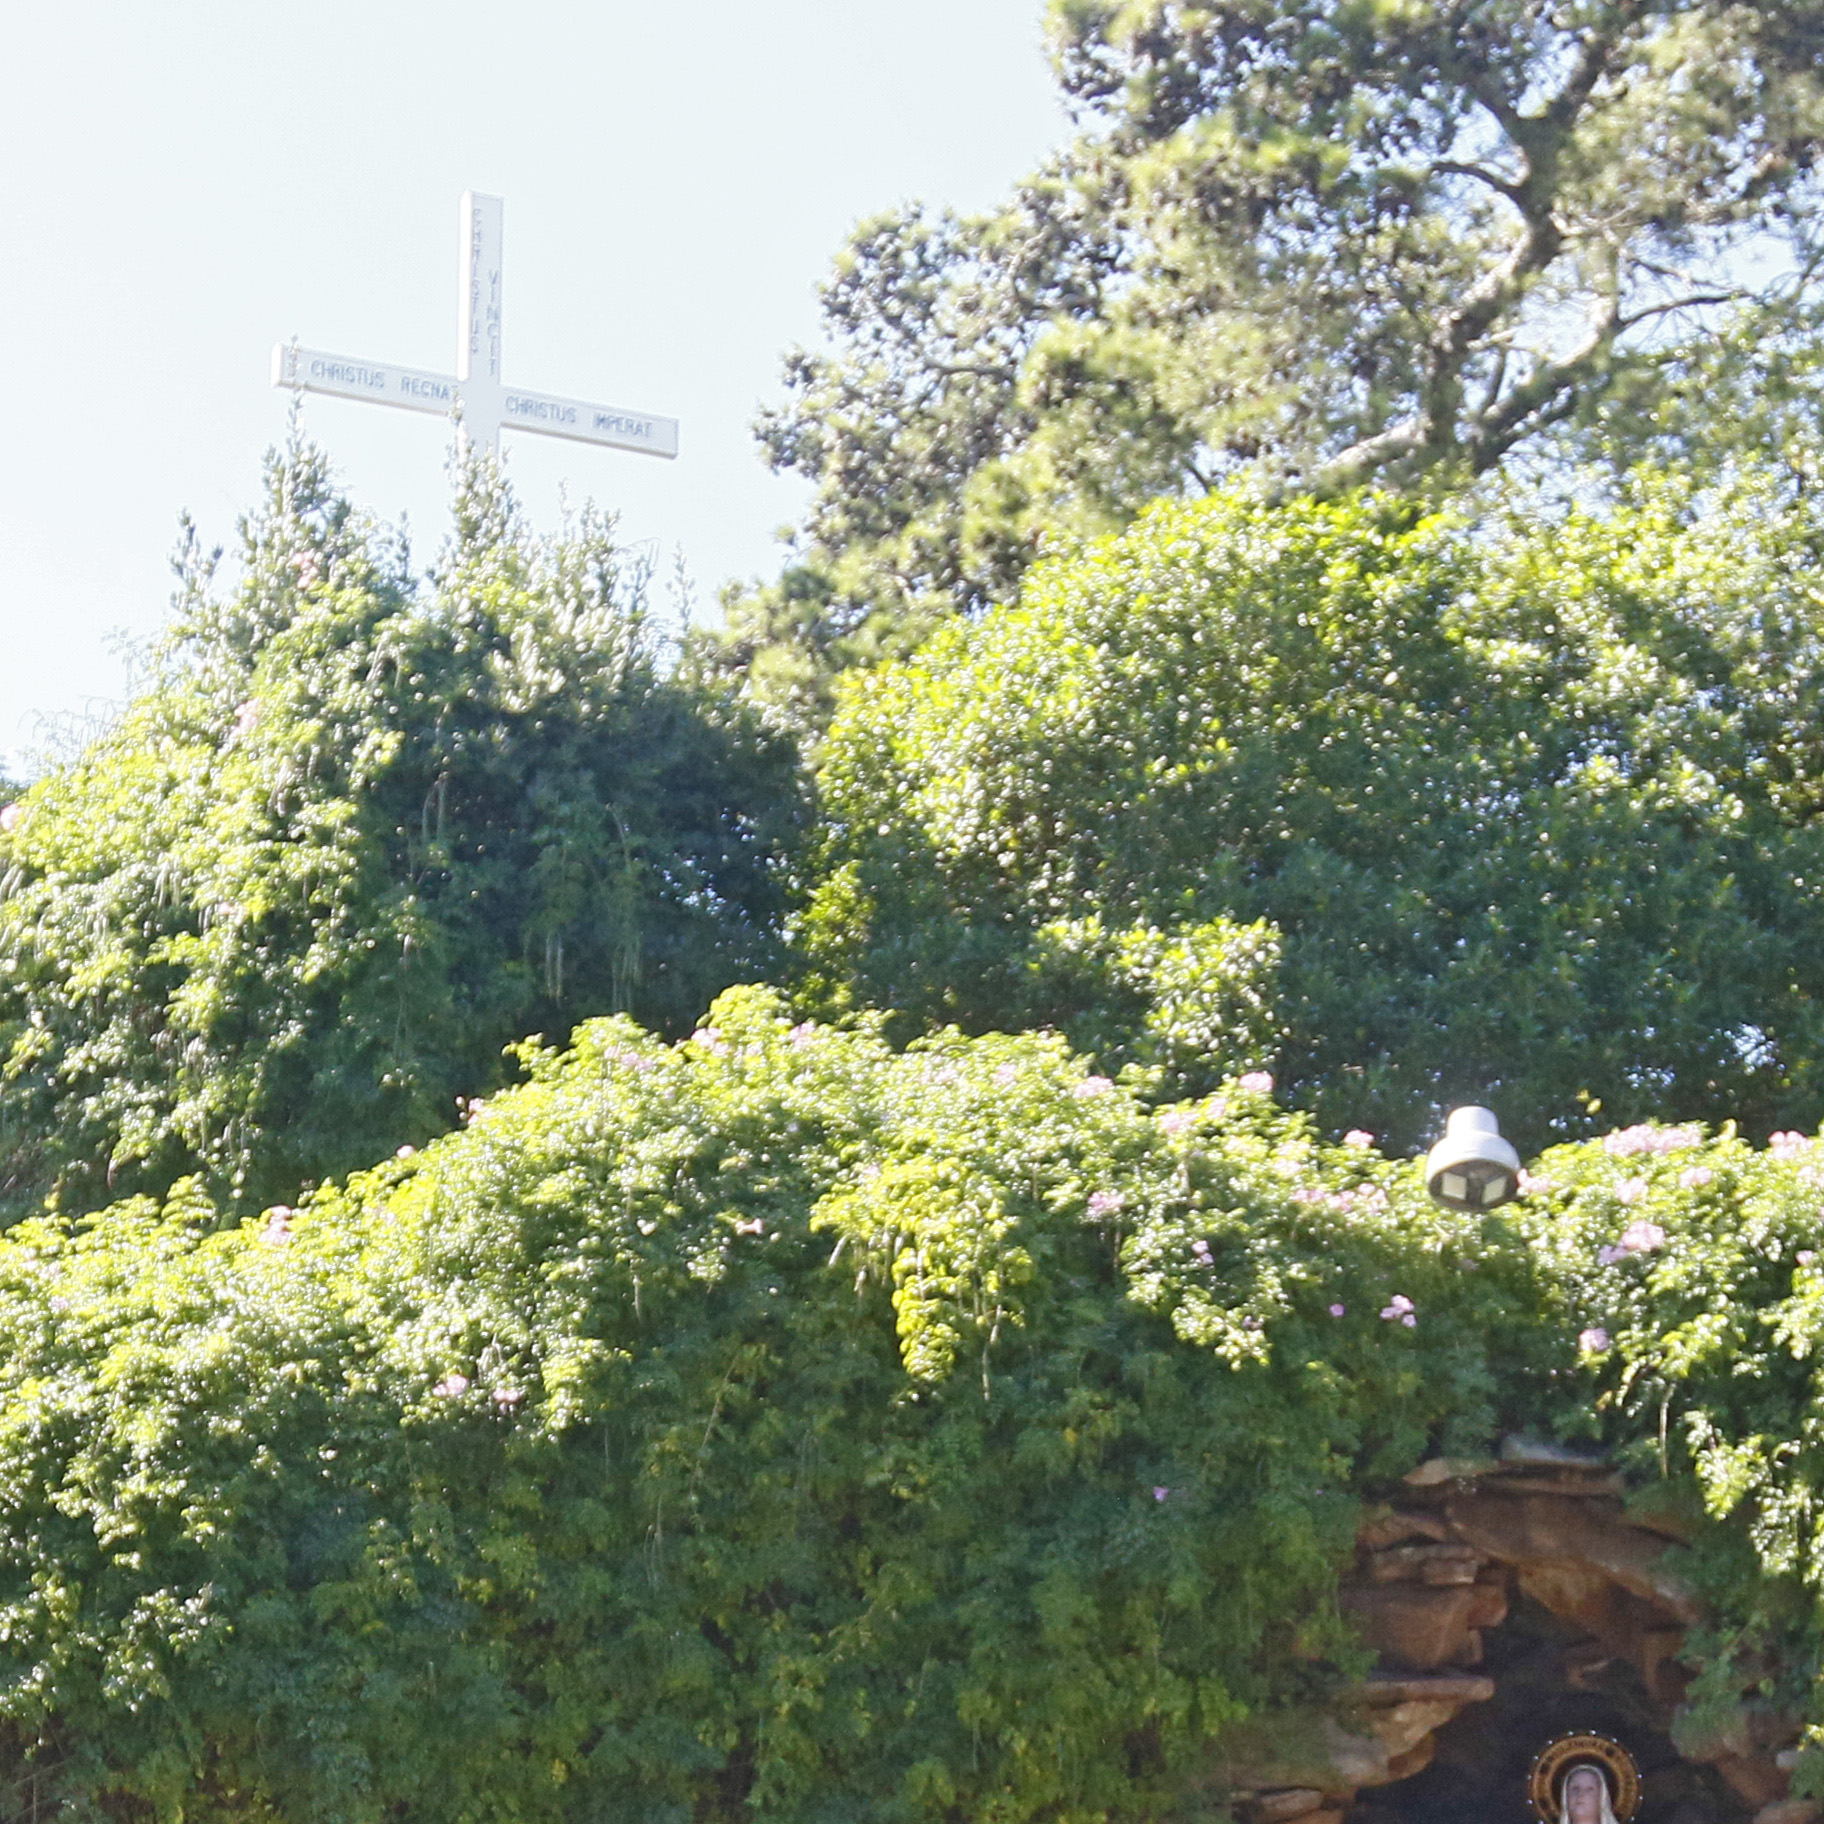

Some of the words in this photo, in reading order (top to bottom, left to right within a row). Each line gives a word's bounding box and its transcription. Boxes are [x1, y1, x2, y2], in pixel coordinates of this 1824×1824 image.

[485, 269, 501, 377] VINCIT
[310, 359, 386, 389] CHRISTUS
[504, 395, 578, 424] CHRISTUS
